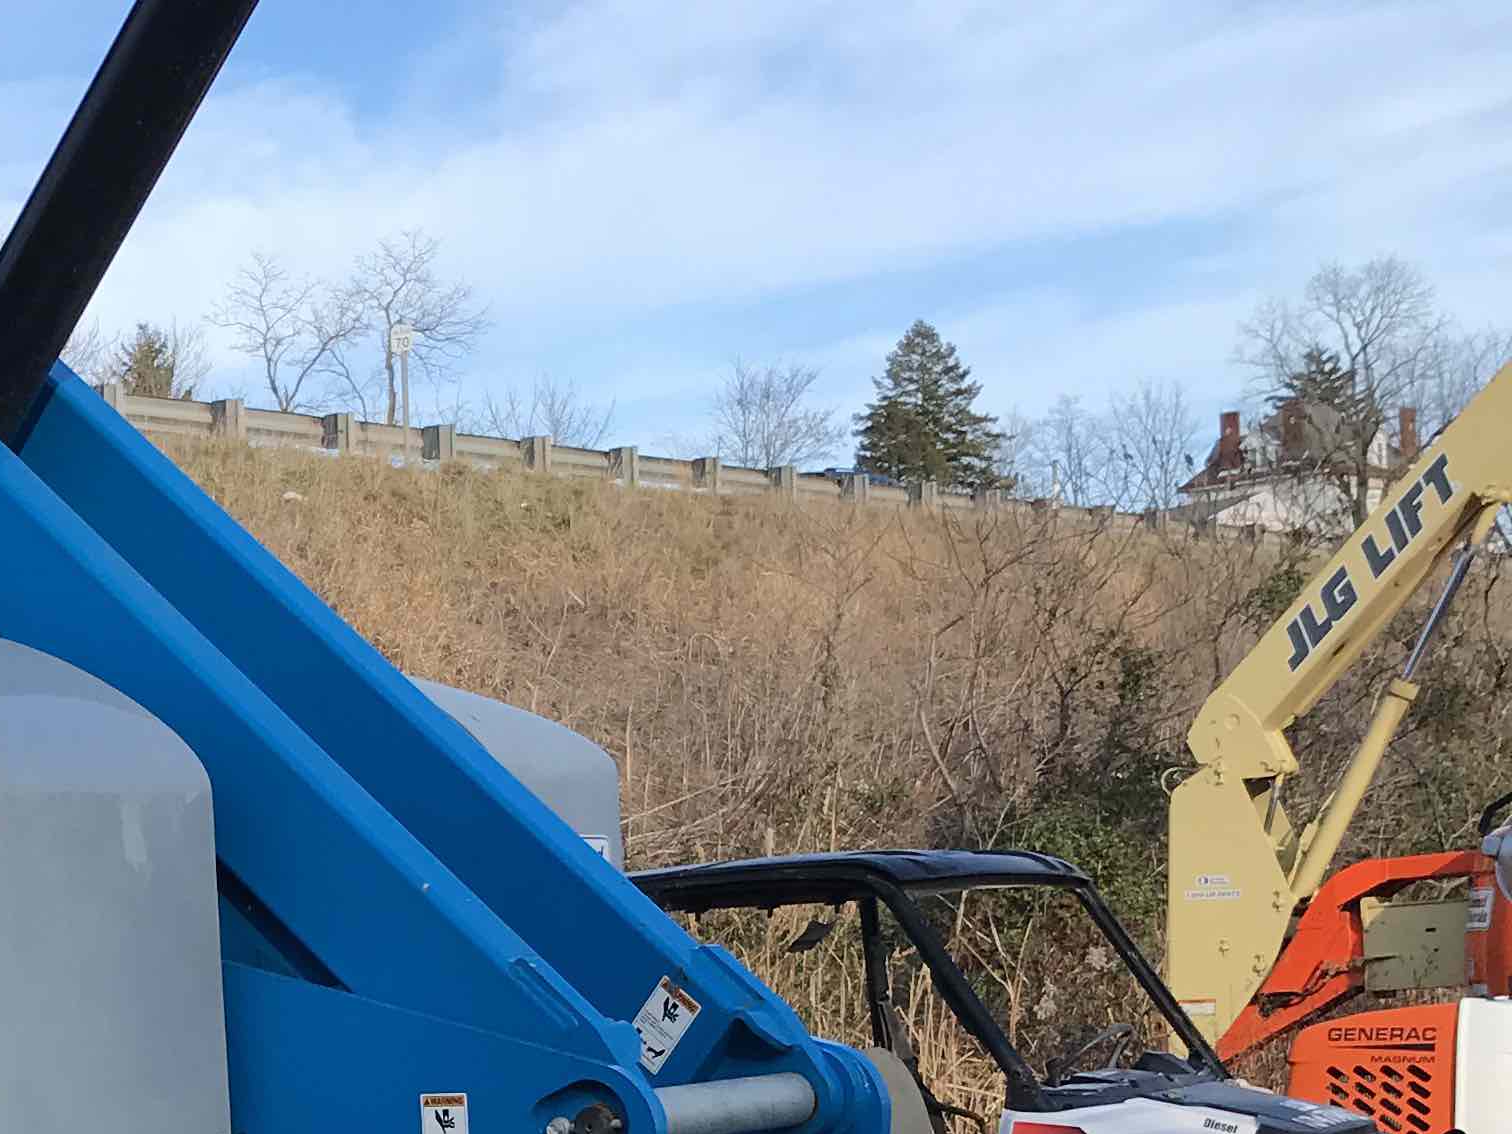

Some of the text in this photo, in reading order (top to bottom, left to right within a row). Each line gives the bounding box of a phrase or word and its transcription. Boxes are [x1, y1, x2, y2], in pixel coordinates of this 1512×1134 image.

[1285, 453, 1454, 673] JLG LIFT
[1327, 1026, 1437, 1042] GENERAC
[1369, 1055, 1436, 1064] MAGNUM
[1202, 1117, 1239, 1134] Diesel
